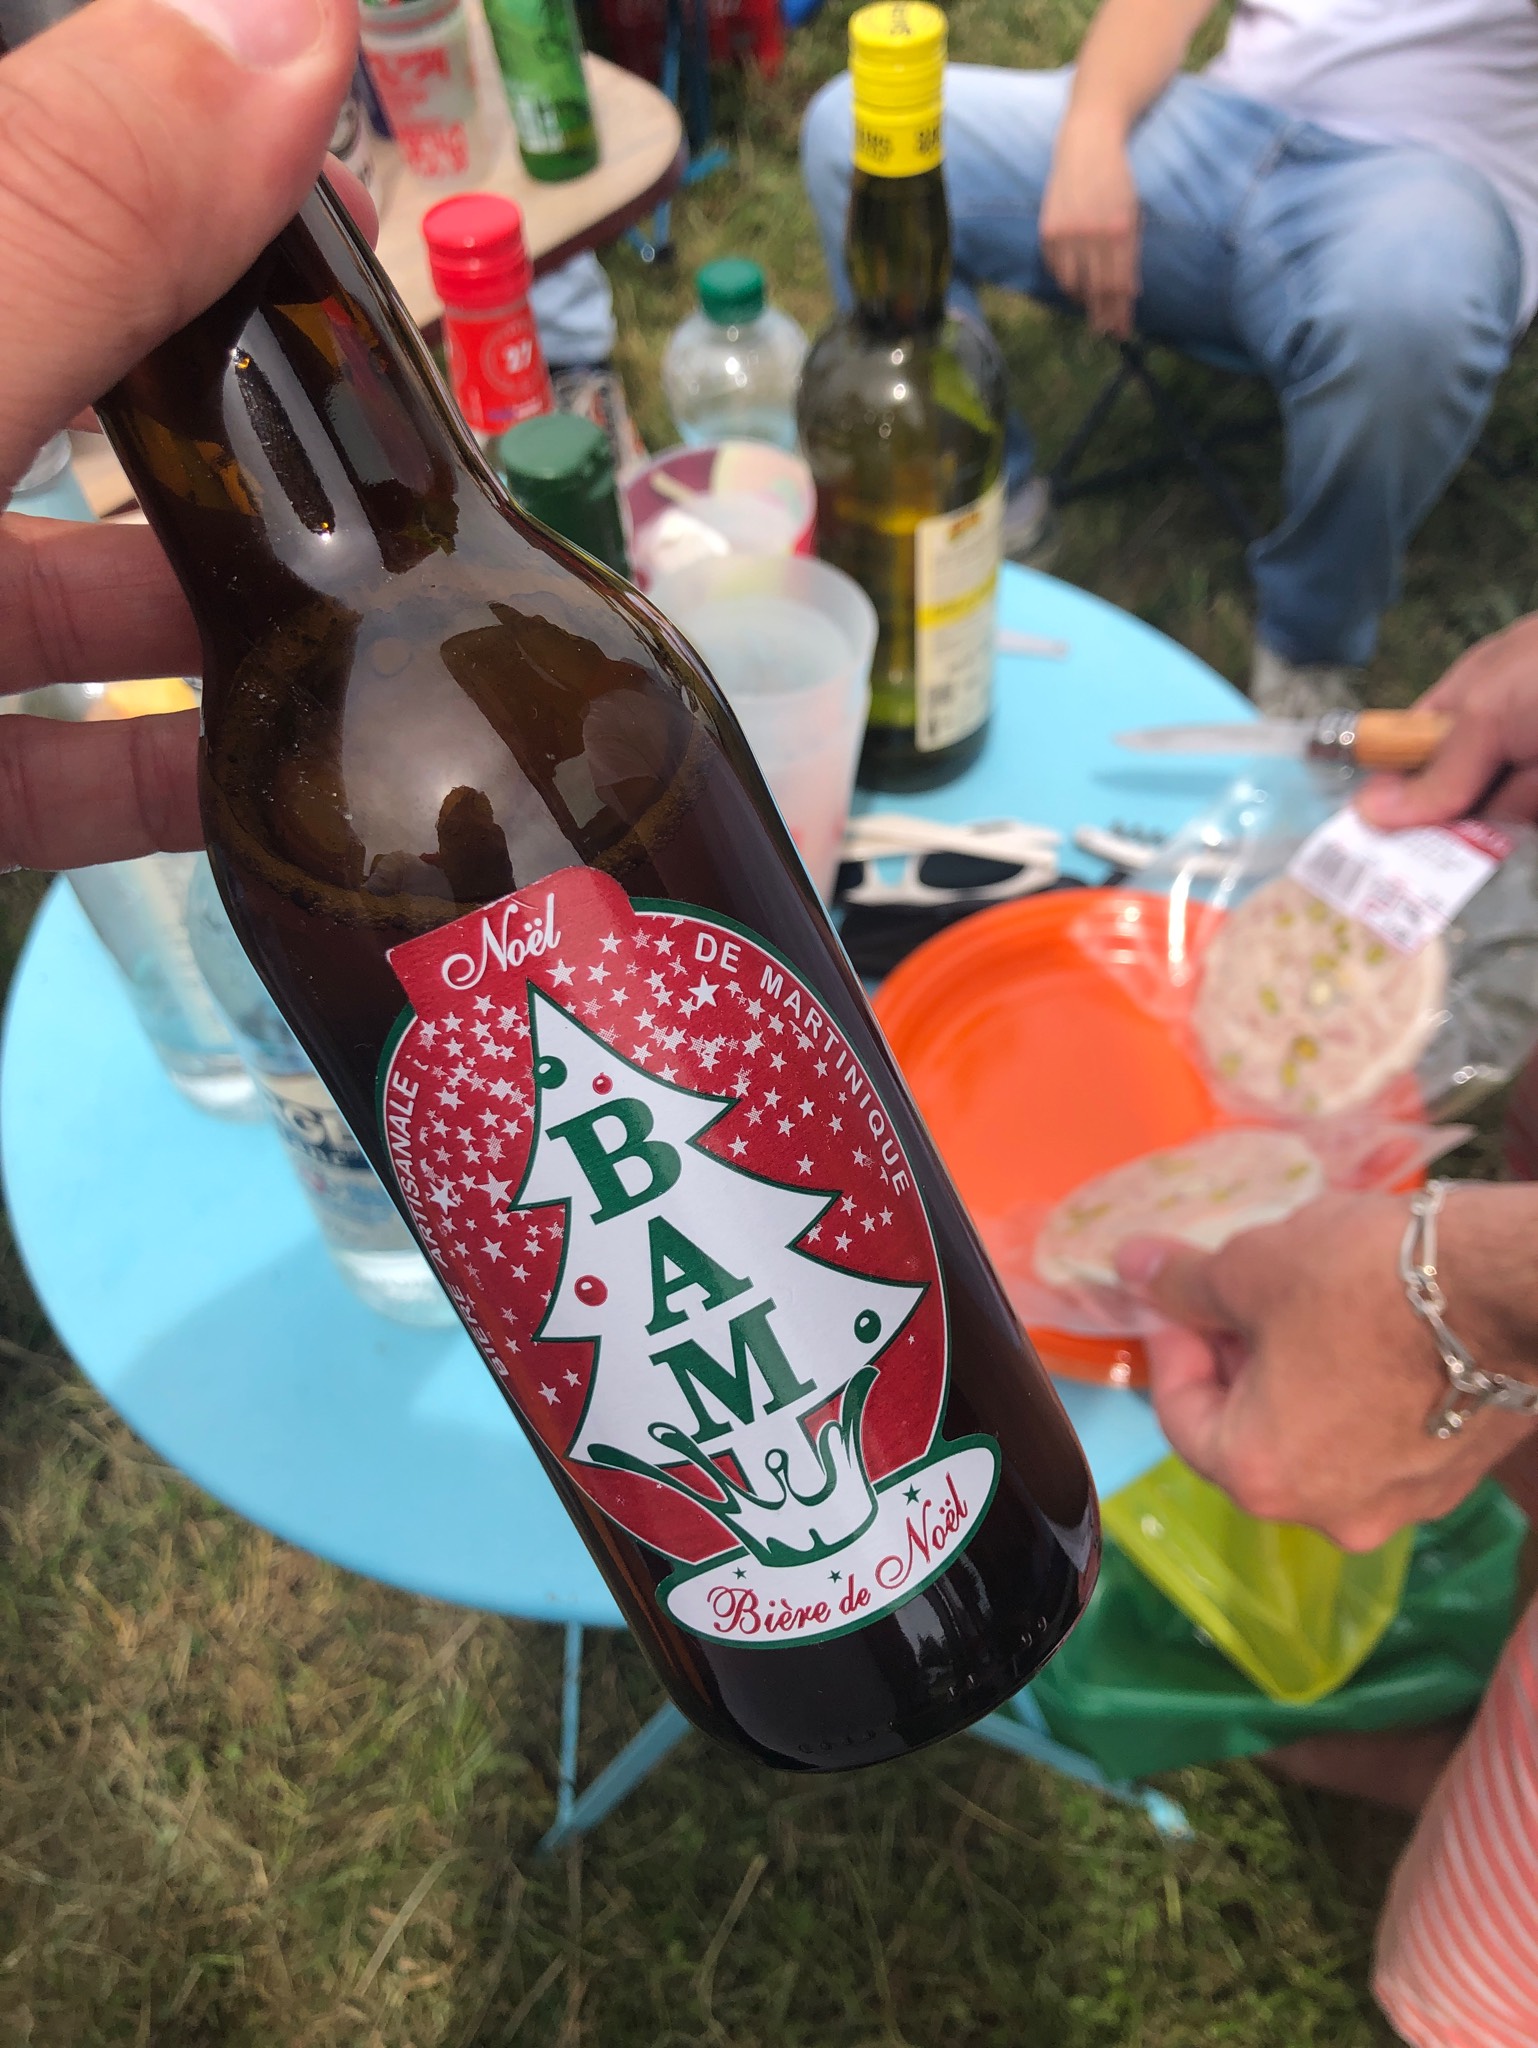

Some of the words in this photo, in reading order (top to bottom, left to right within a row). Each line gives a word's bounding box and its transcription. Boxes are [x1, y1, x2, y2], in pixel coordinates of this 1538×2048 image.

[441, 892, 562, 990] Noël
[387, 1071, 448, 1269] ARTISANALE
[694, 932, 742, 974] DE
[759, 964, 910, 1197] MARTINIQUE
[545, 1097, 818, 1445] BAM
[706, 1585, 831, 1635] Bière
[838, 1573, 872, 1616] de
[874, 1471, 969, 1590] Noël
